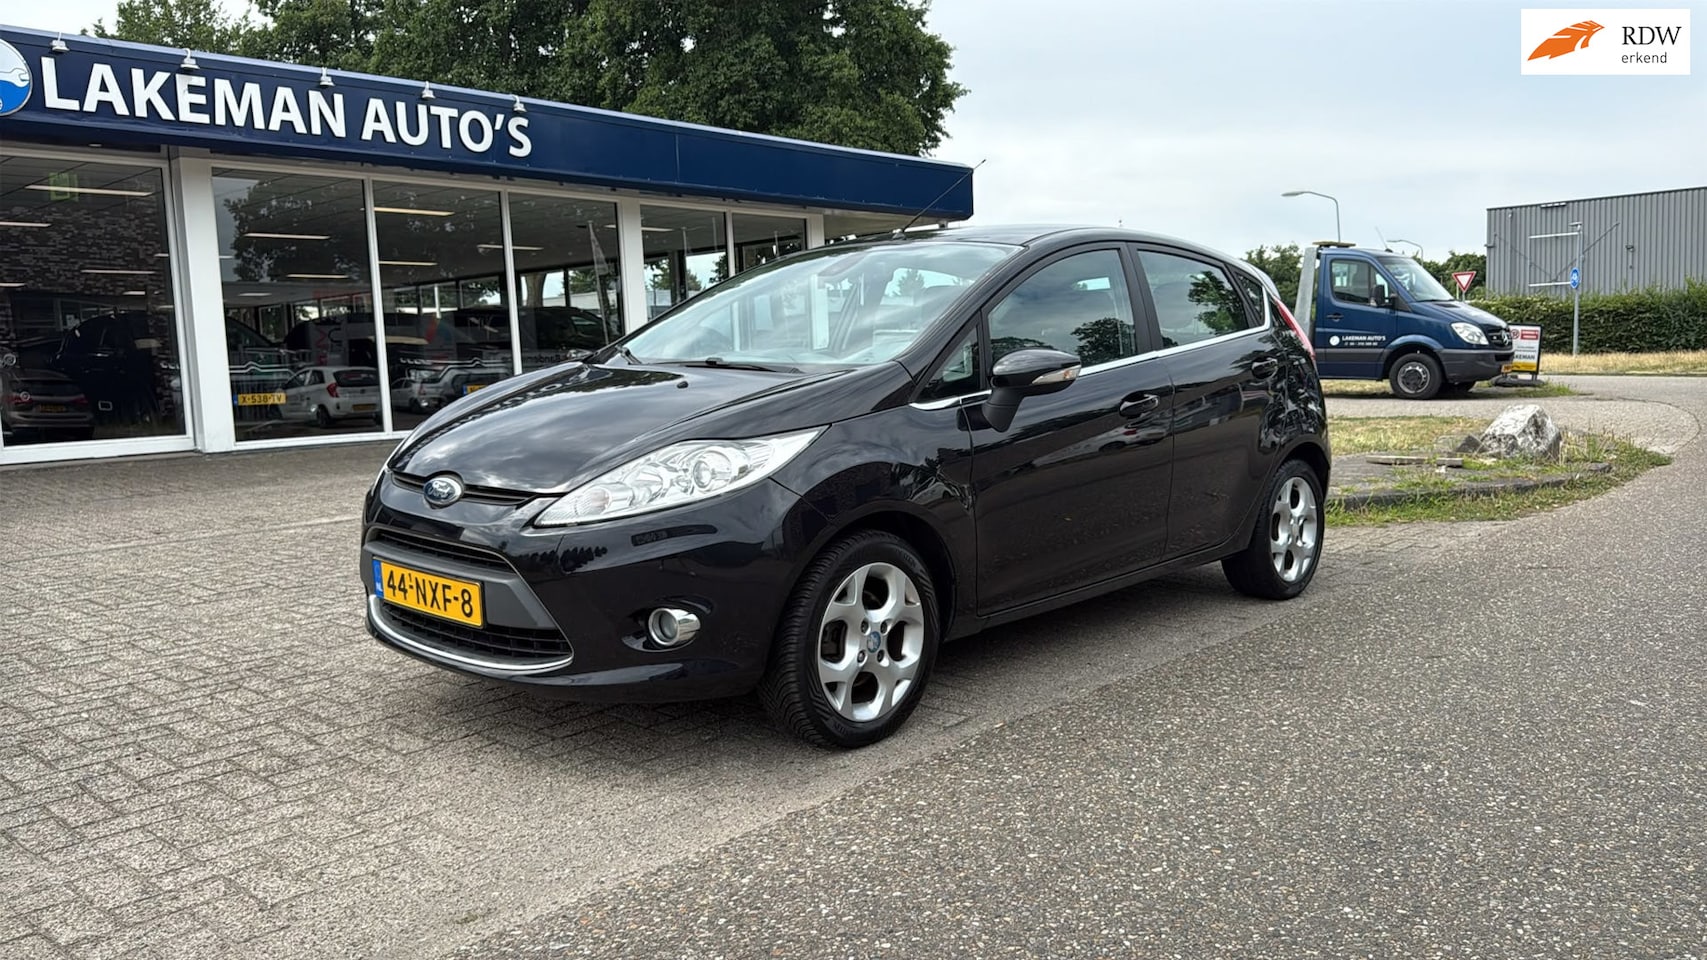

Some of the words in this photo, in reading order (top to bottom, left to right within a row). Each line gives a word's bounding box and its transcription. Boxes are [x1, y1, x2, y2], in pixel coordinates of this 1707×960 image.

[41, 56, 346, 138] LAKEMAN
[361, 98, 532, 157] AUTO'S
[387, 569, 473, 618] 44-NXF-8
